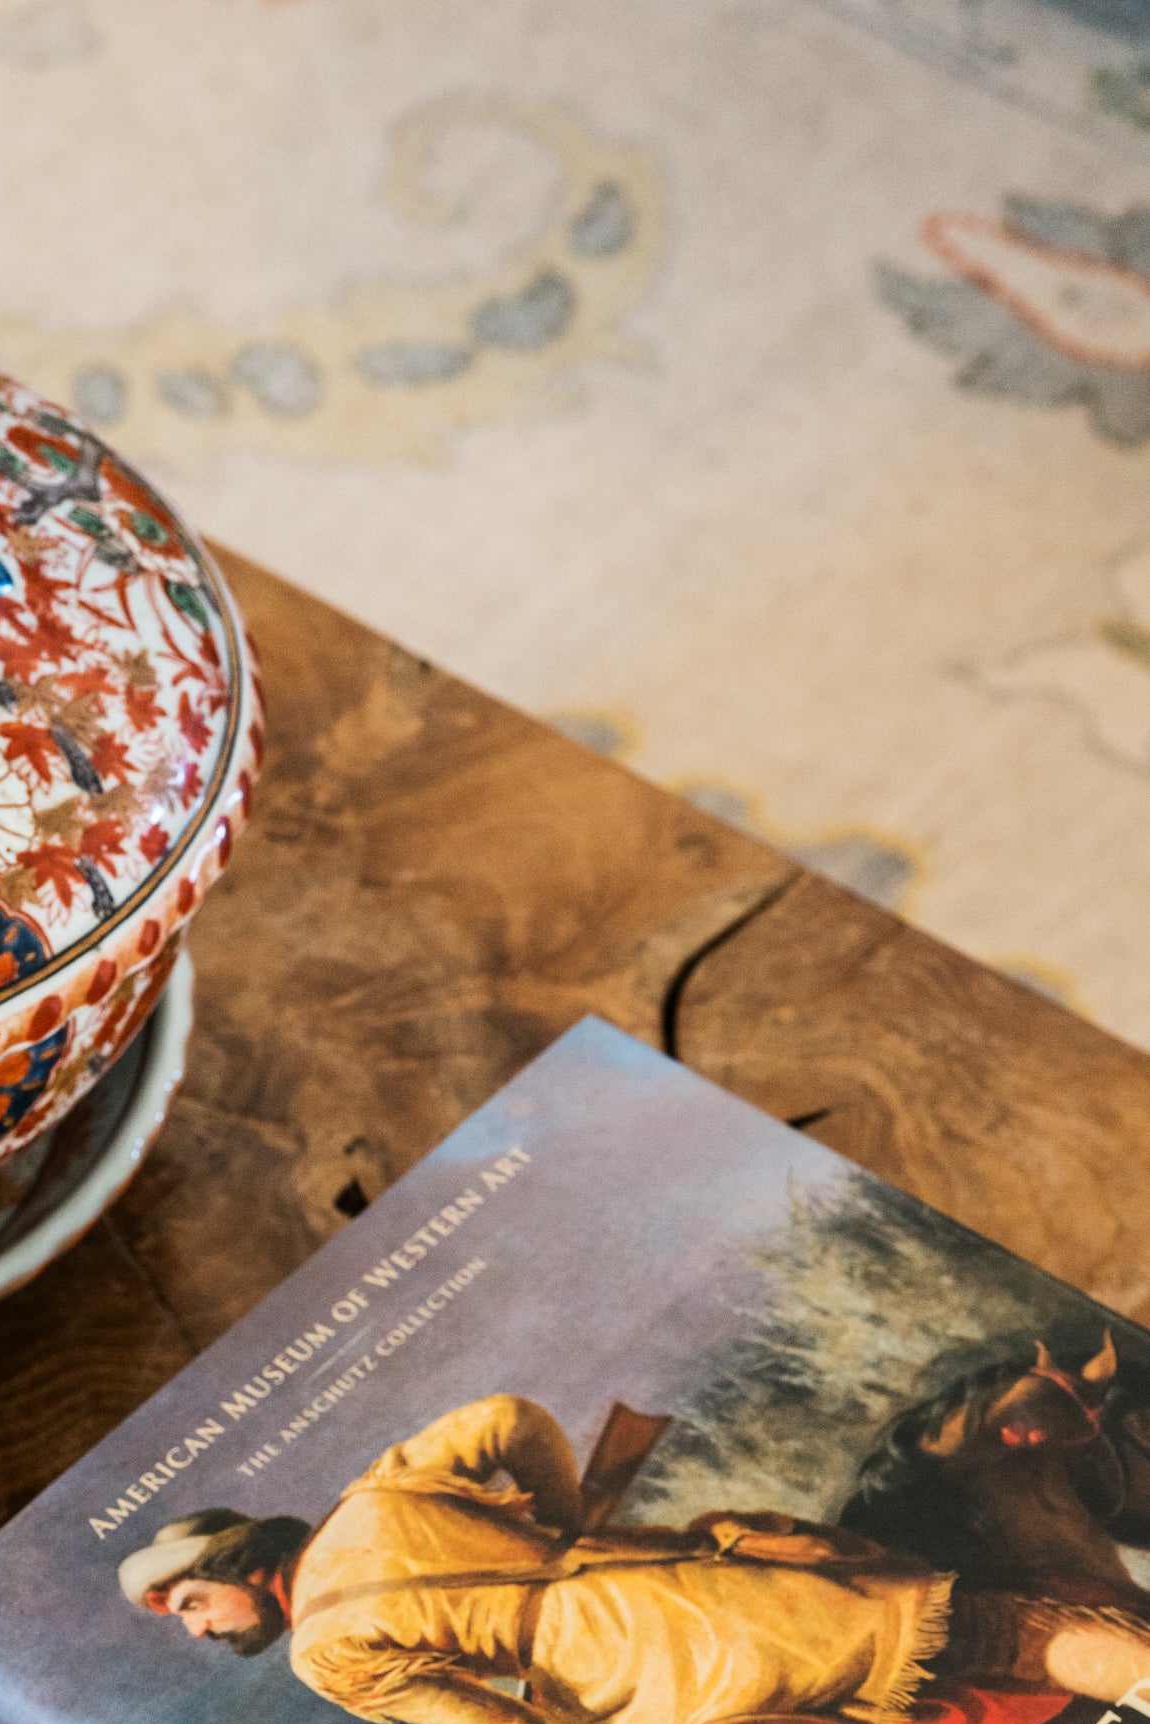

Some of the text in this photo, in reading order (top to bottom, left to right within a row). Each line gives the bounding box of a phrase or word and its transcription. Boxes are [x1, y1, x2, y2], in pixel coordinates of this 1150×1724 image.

[88, 1146, 532, 1540] AMERICAN MUSEUM OF WESTERN ART
[237, 1257, 488, 1480] THE ANSCHUTZ COLLECTION
